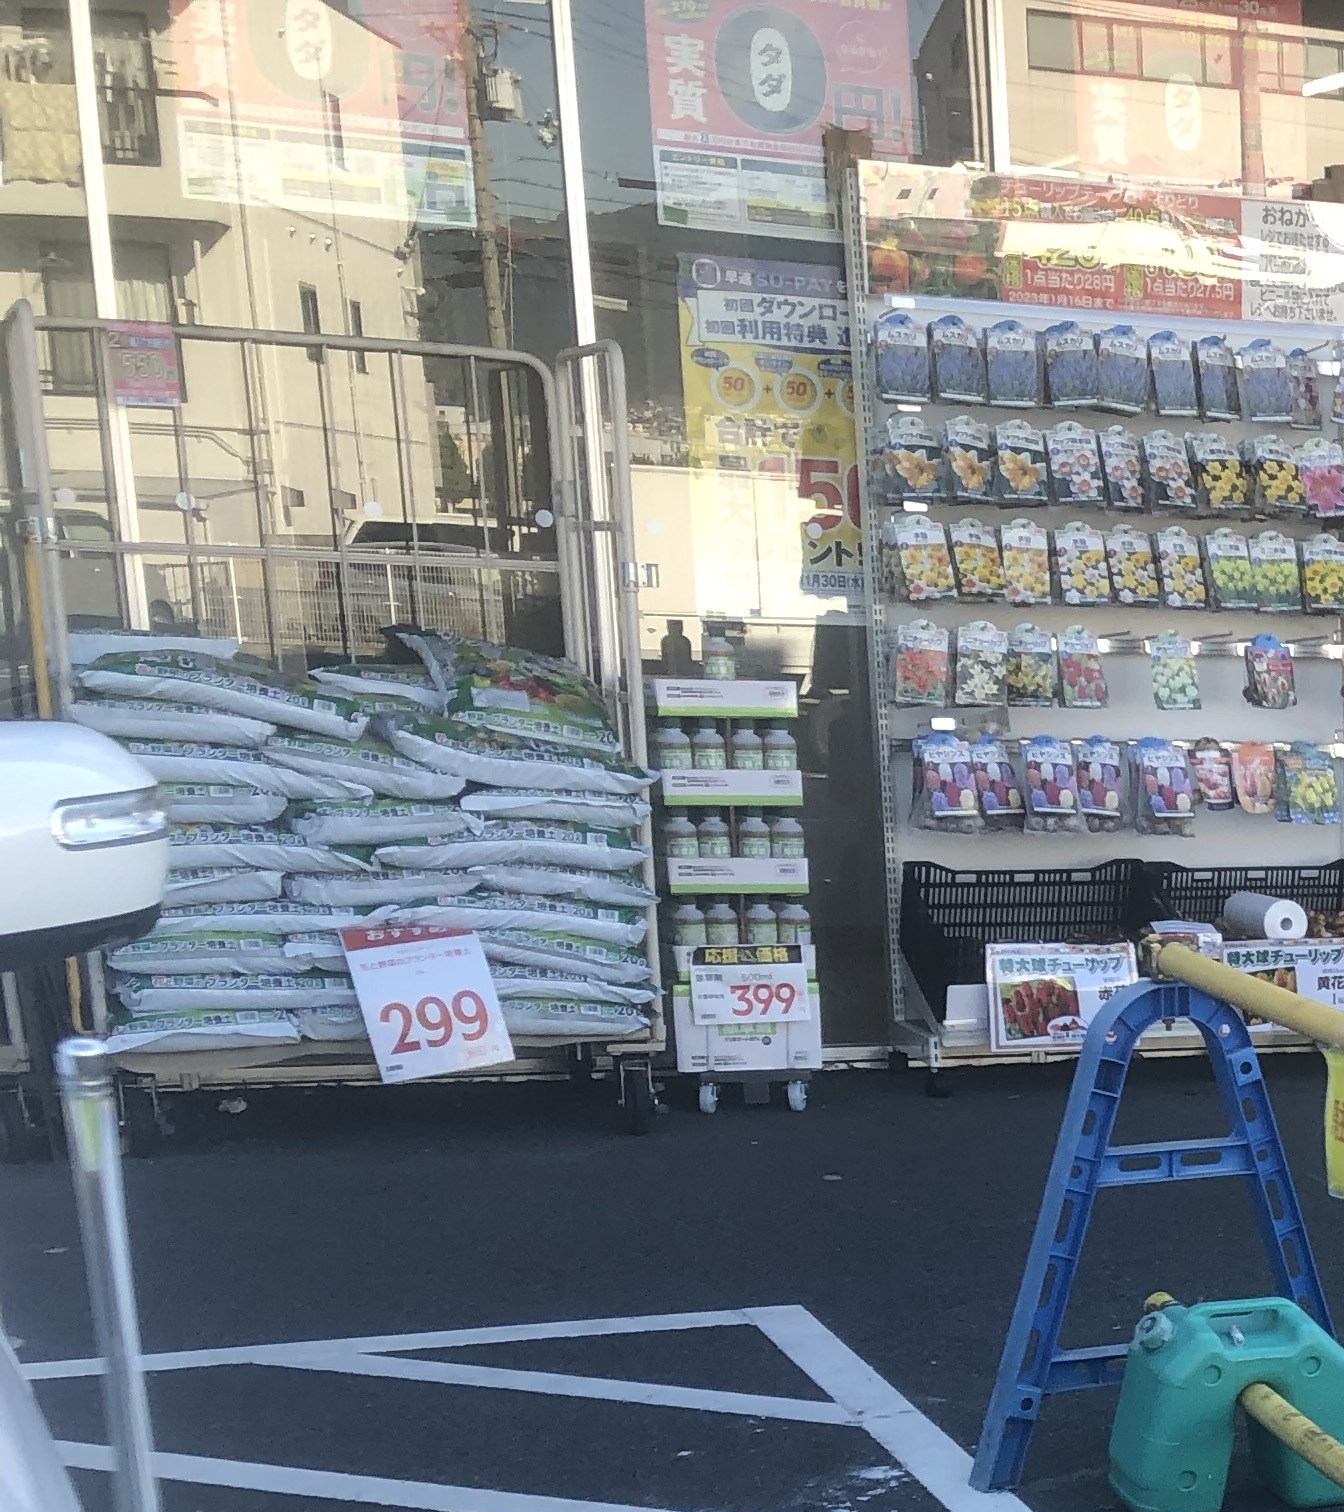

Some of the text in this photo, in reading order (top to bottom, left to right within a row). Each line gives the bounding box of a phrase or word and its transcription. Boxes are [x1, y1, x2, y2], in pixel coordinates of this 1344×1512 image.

[663, 33, 708, 124] 実質
[757, 42, 787, 98] タダ
[722, 375, 808, 397] 50 50
[755, 946, 790, 963] 価格
[729, 981, 797, 1017] 399
[378, 989, 489, 1057] 299
